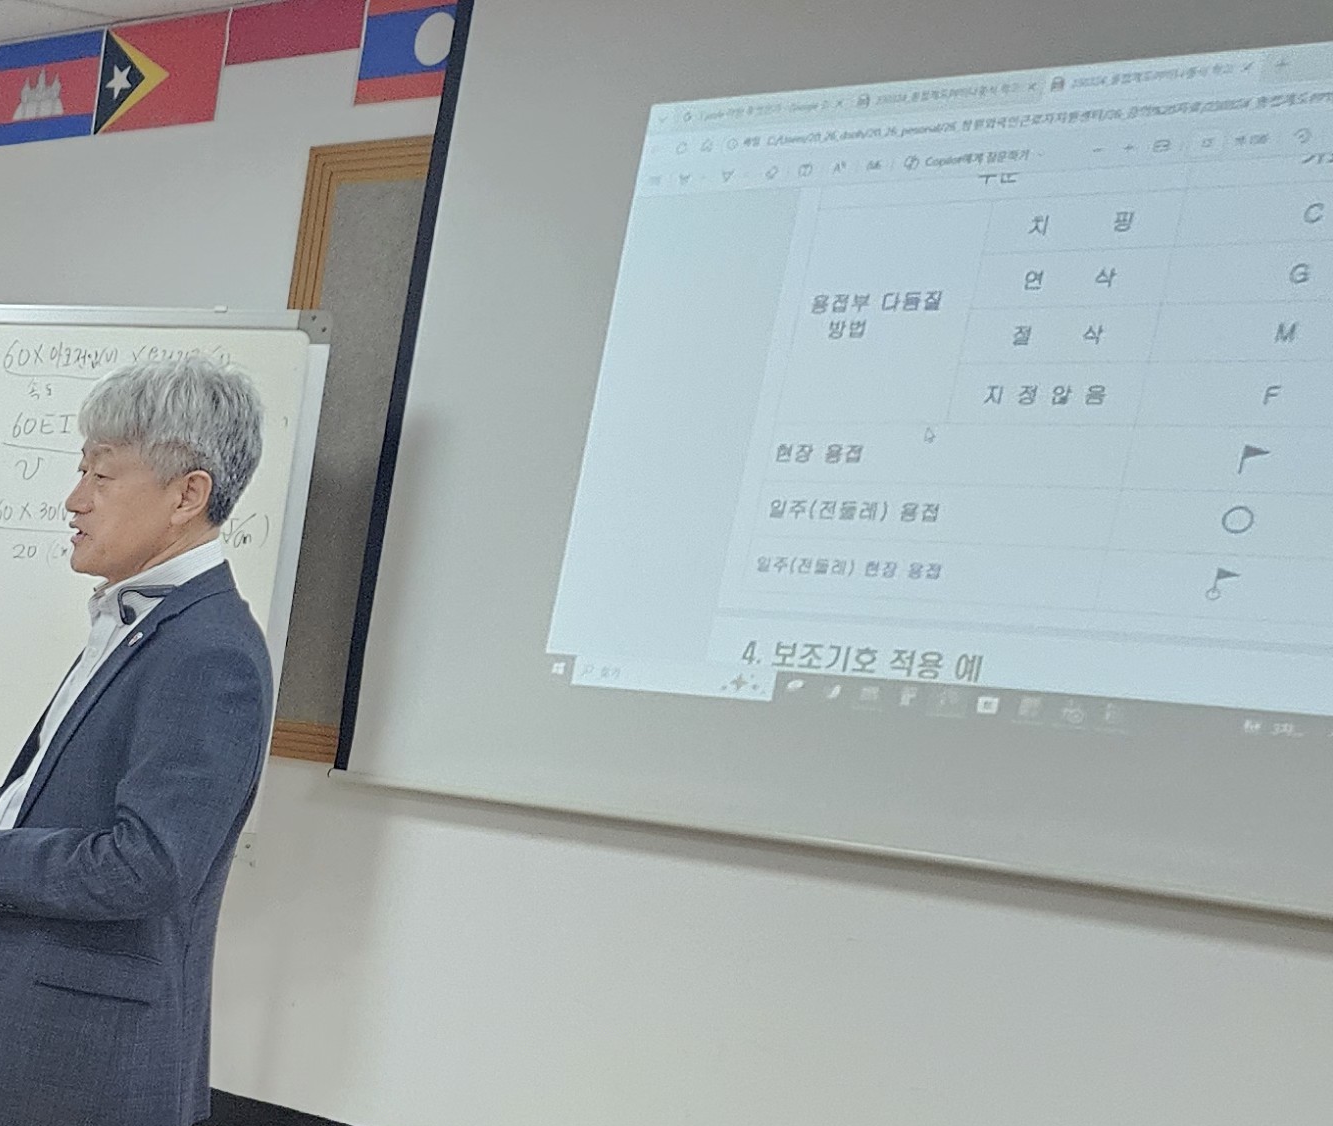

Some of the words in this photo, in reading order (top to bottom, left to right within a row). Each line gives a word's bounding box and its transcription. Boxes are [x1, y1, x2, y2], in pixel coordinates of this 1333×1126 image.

[1303, 202, 1325, 224] C
[1024, 269, 1044, 290] 연
[1095, 267, 1117, 288] 삭
[1289, 263, 1310, 284] G
[811, 293, 871, 314] 용접부
[881, 291, 943, 312] 다듬질
[828, 319, 867, 340] 방법
[1082, 324, 1104, 345] 삭
[1274, 322, 1298, 343] M
[1263, 384, 1282, 405] F
[775, 443, 814, 463] 현장
[824, 443, 864, 464] 용접
[769, 498, 888, 522] 일주(전둘레)
[900, 502, 940, 523] 용접
[865, 559, 898, 578] 현장
[907, 562, 942, 580] 용접
[742, 640, 761, 666] 4.
[771, 641, 879, 674] 보조기호
[889, 649, 943, 680] 적용
[955, 653, 984, 684] 예
